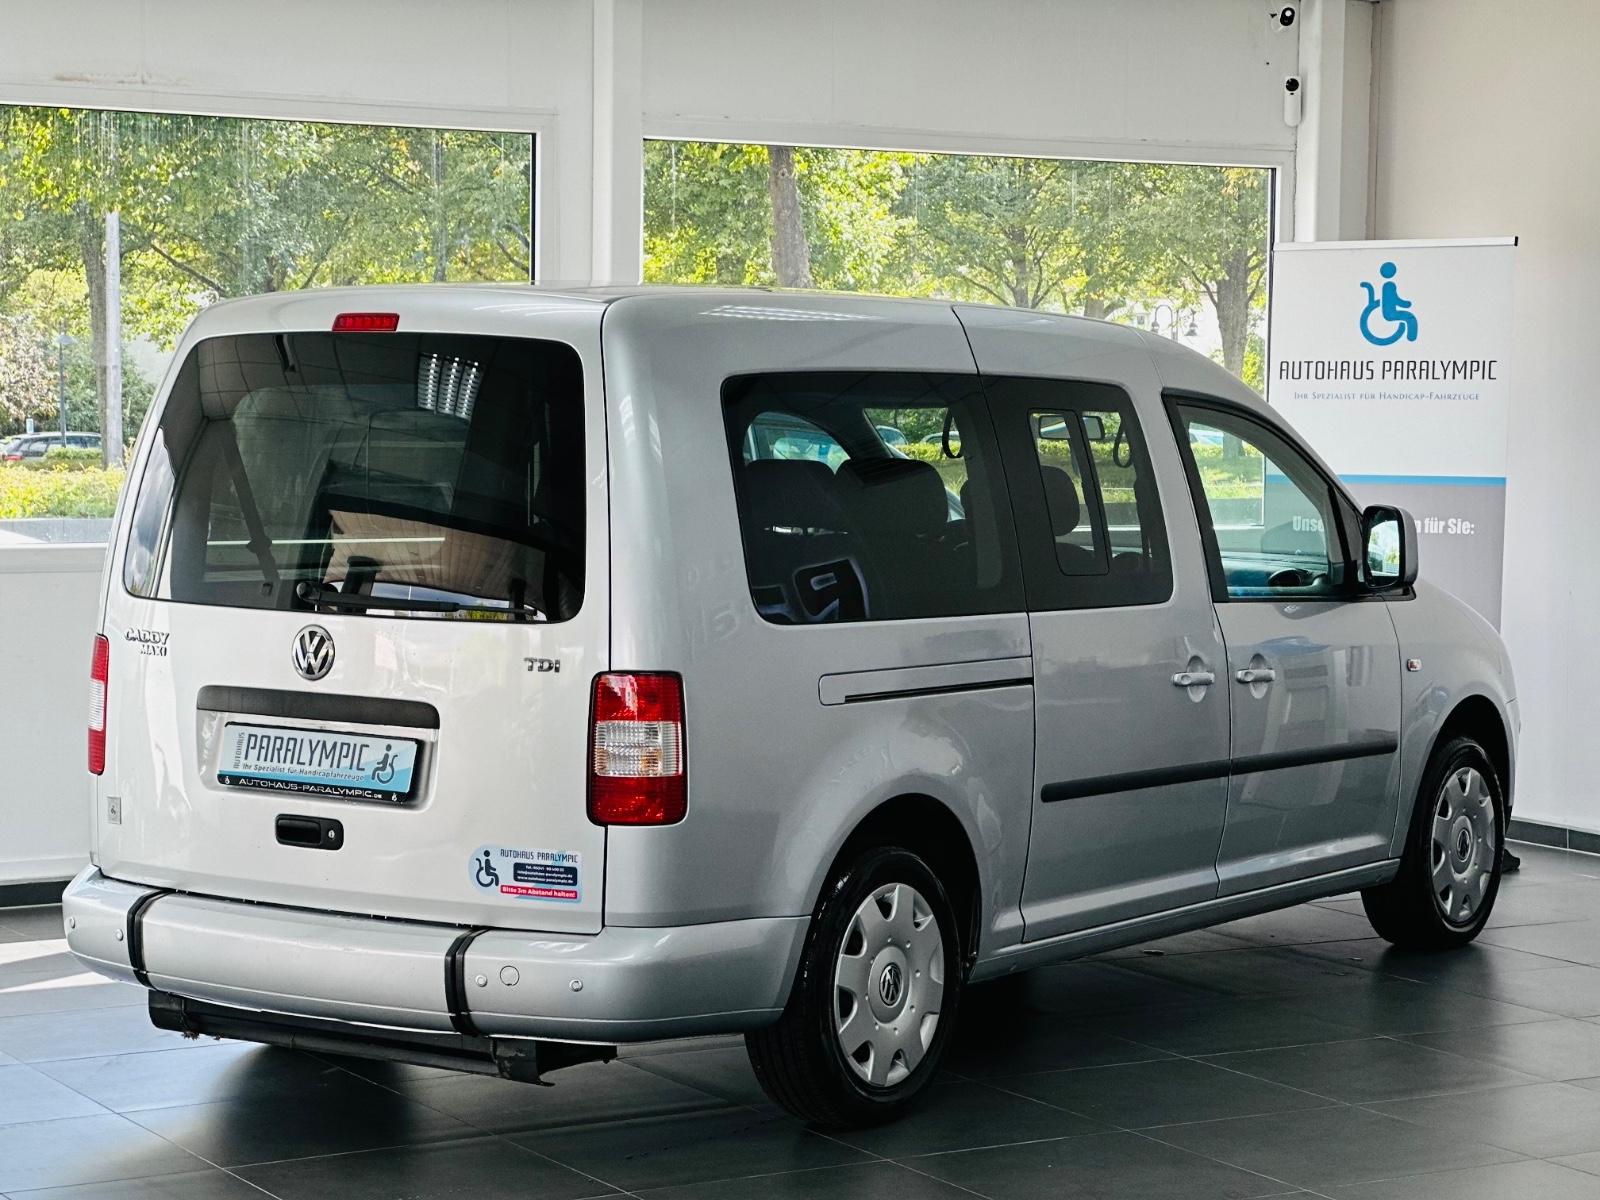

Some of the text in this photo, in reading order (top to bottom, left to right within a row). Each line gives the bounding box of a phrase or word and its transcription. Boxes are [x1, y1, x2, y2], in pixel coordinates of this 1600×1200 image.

[1279, 360, 1497, 380] AUTOHAUS PARALYMPIC
[1424, 517, 1446, 534] für
[1447, 518, 1475, 535] Sie:
[523, 657, 561, 673] TDI
[244, 733, 370, 772] PARALYMPIC
[253, 764, 285, 773] Spezialist
[500, 848, 579, 864] AUTOHAUS PARALYMPIC
[528, 888, 553, 897] Abstand
